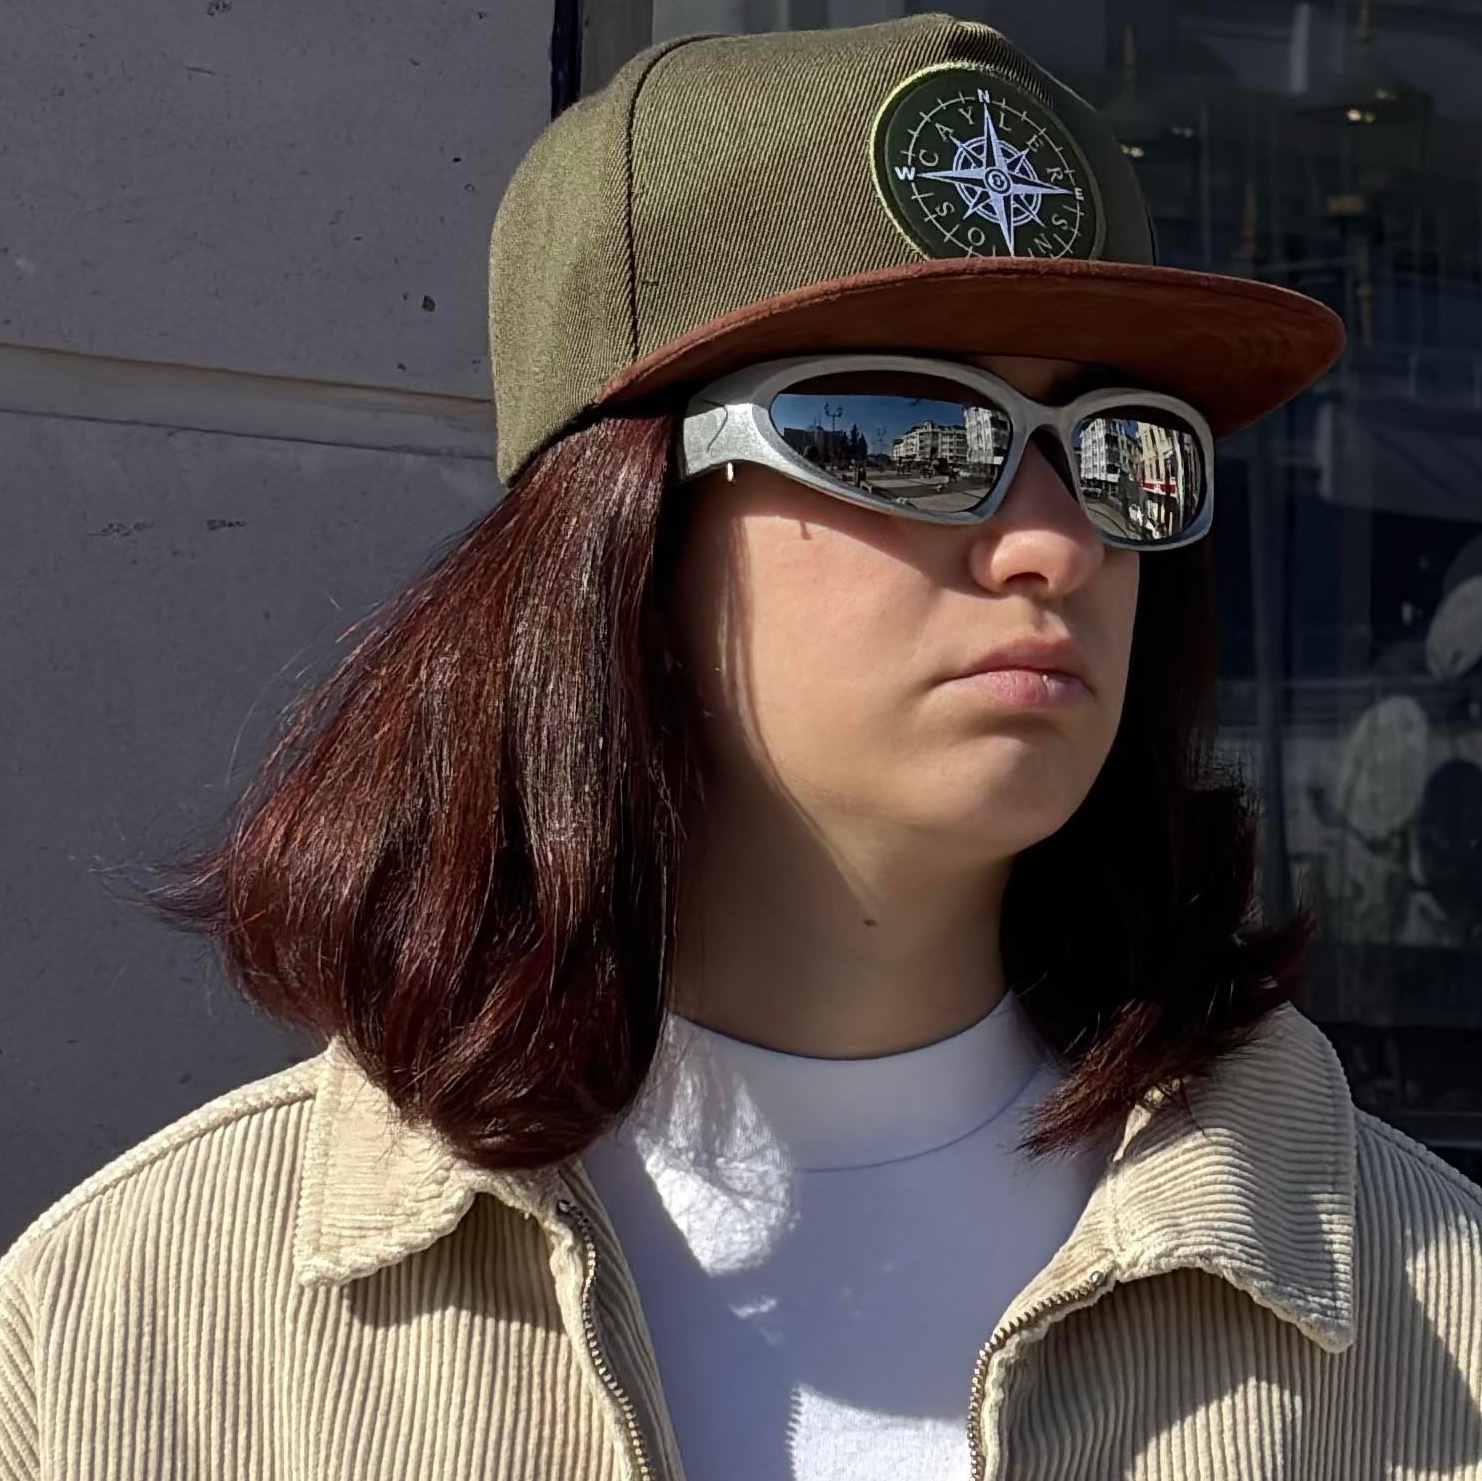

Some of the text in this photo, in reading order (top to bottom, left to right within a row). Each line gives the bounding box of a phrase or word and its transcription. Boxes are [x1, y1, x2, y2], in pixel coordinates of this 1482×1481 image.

[978, 89, 990, 103] N
[919, 105, 1064, 181] CAYLER
[894, 166, 916, 180] W
[1074, 188, 1085, 200] E
[936, 201, 1069, 253] SONS
